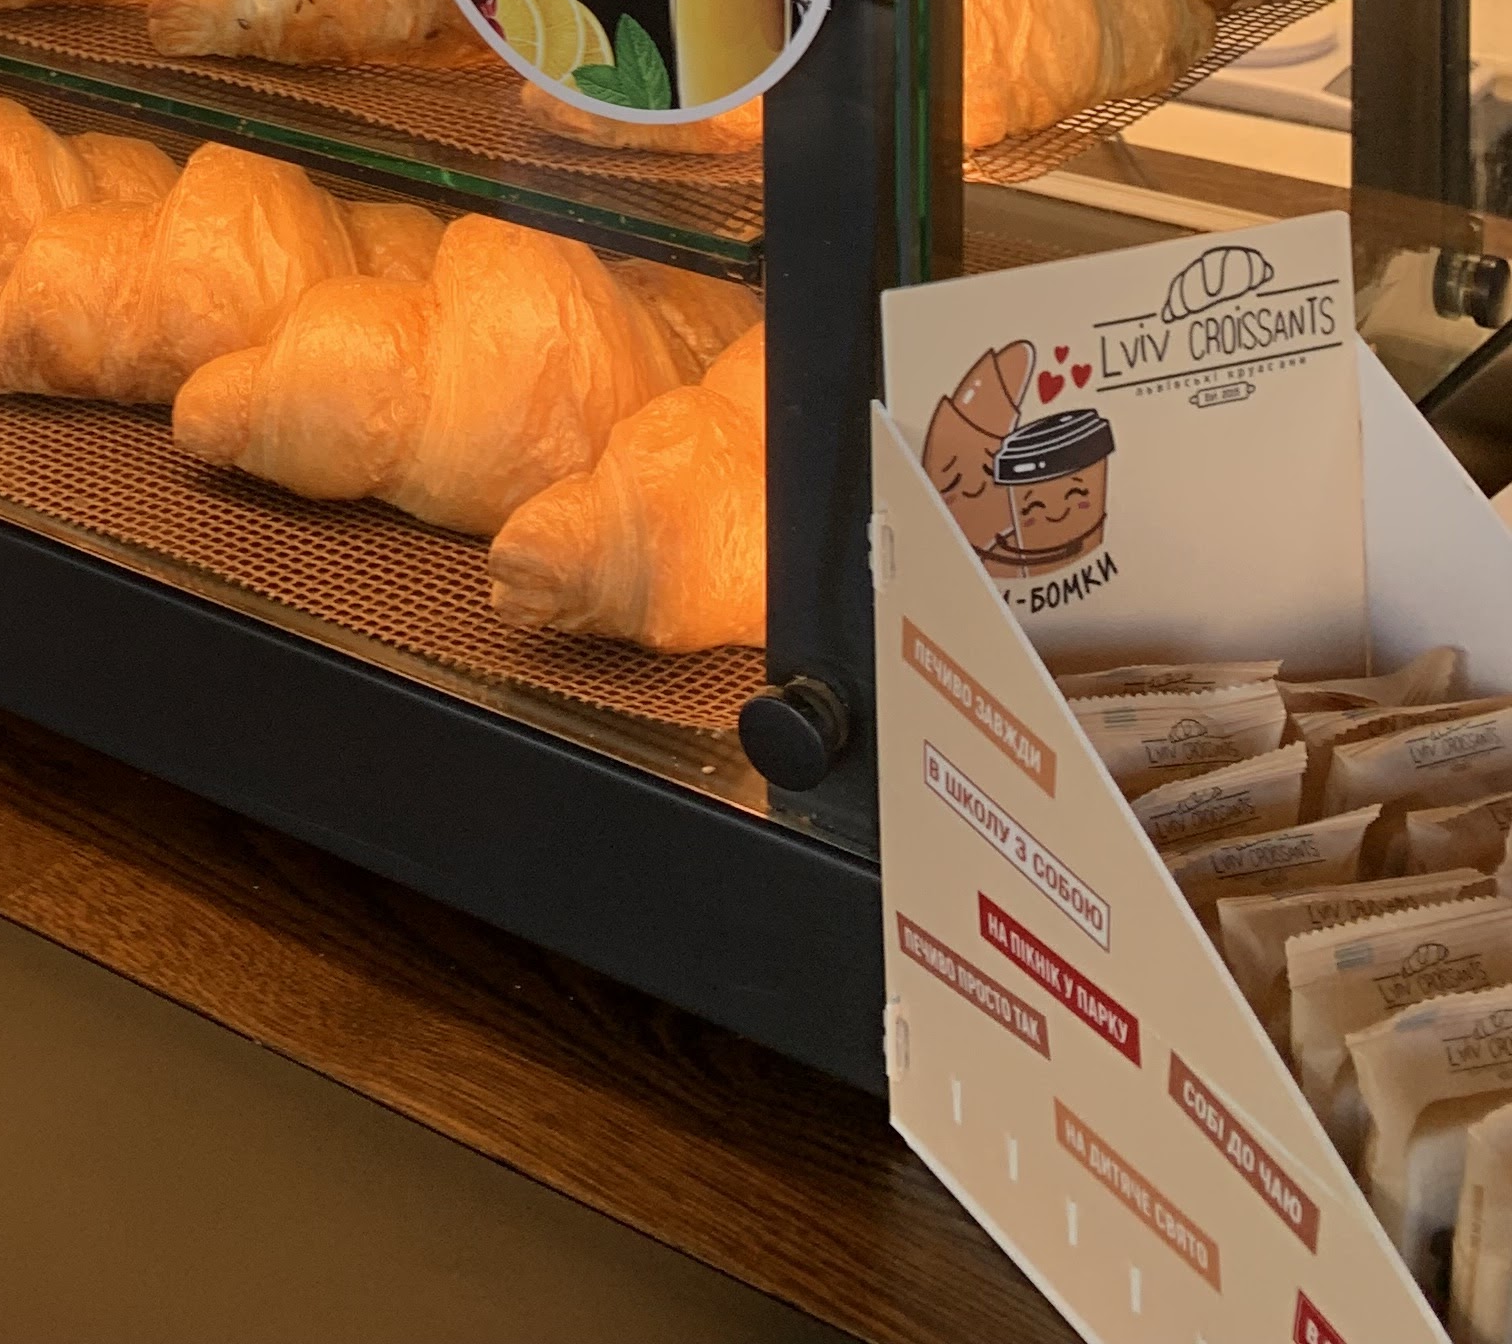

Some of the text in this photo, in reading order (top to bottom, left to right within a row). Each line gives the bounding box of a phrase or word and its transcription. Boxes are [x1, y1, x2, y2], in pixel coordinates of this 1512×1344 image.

[912, 637, 1043, 776] ПЕЧИВО ЗАВЖДИ
[928, 755, 1105, 933] В ШКОЛУ З СОБОЮ
[903, 926, 1041, 1047] ПЕЧИВО ПРОСТО ТАК
[986, 911, 1129, 1045] НА ПІКНІК У ПАРКУ
[1064, 1118, 1209, 1271] НА ДИТЯЧЕ СВЯТО
[1182, 1078, 1305, 1225] СОБІ ДО ЧАЮ
